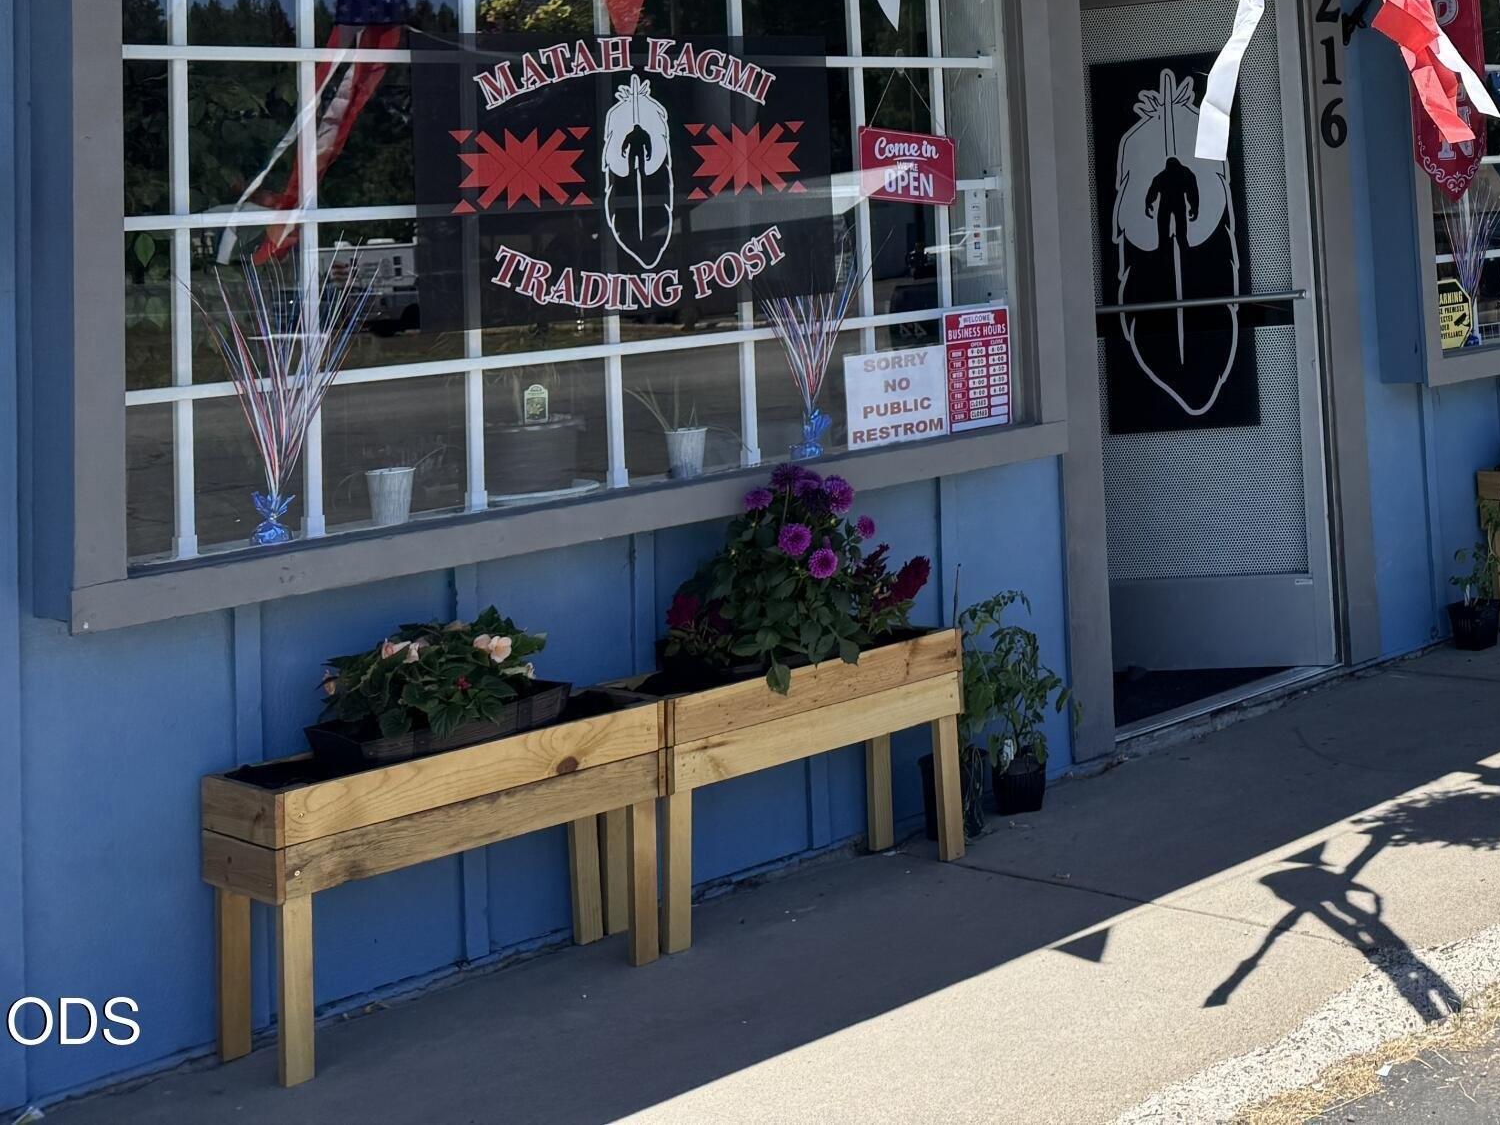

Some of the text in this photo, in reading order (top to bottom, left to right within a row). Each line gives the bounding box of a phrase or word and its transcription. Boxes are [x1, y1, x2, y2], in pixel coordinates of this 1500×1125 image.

[472, 36, 777, 111] MATAH KAGMI
[874, 136, 939, 159] Come in
[884, 168, 934, 197] OPEN
[491, 225, 786, 311] TRADING POST
[1439, 291, 1463, 305] ARNING
[963, 314, 990, 323] WELCOME
[948, 323, 1006, 340] BUSINESS HOURS
[863, 351, 929, 373] SORRY
[883, 377, 911, 393] NO
[863, 397, 932, 419] PUBLIC
[852, 417, 944, 444] RESTROM
